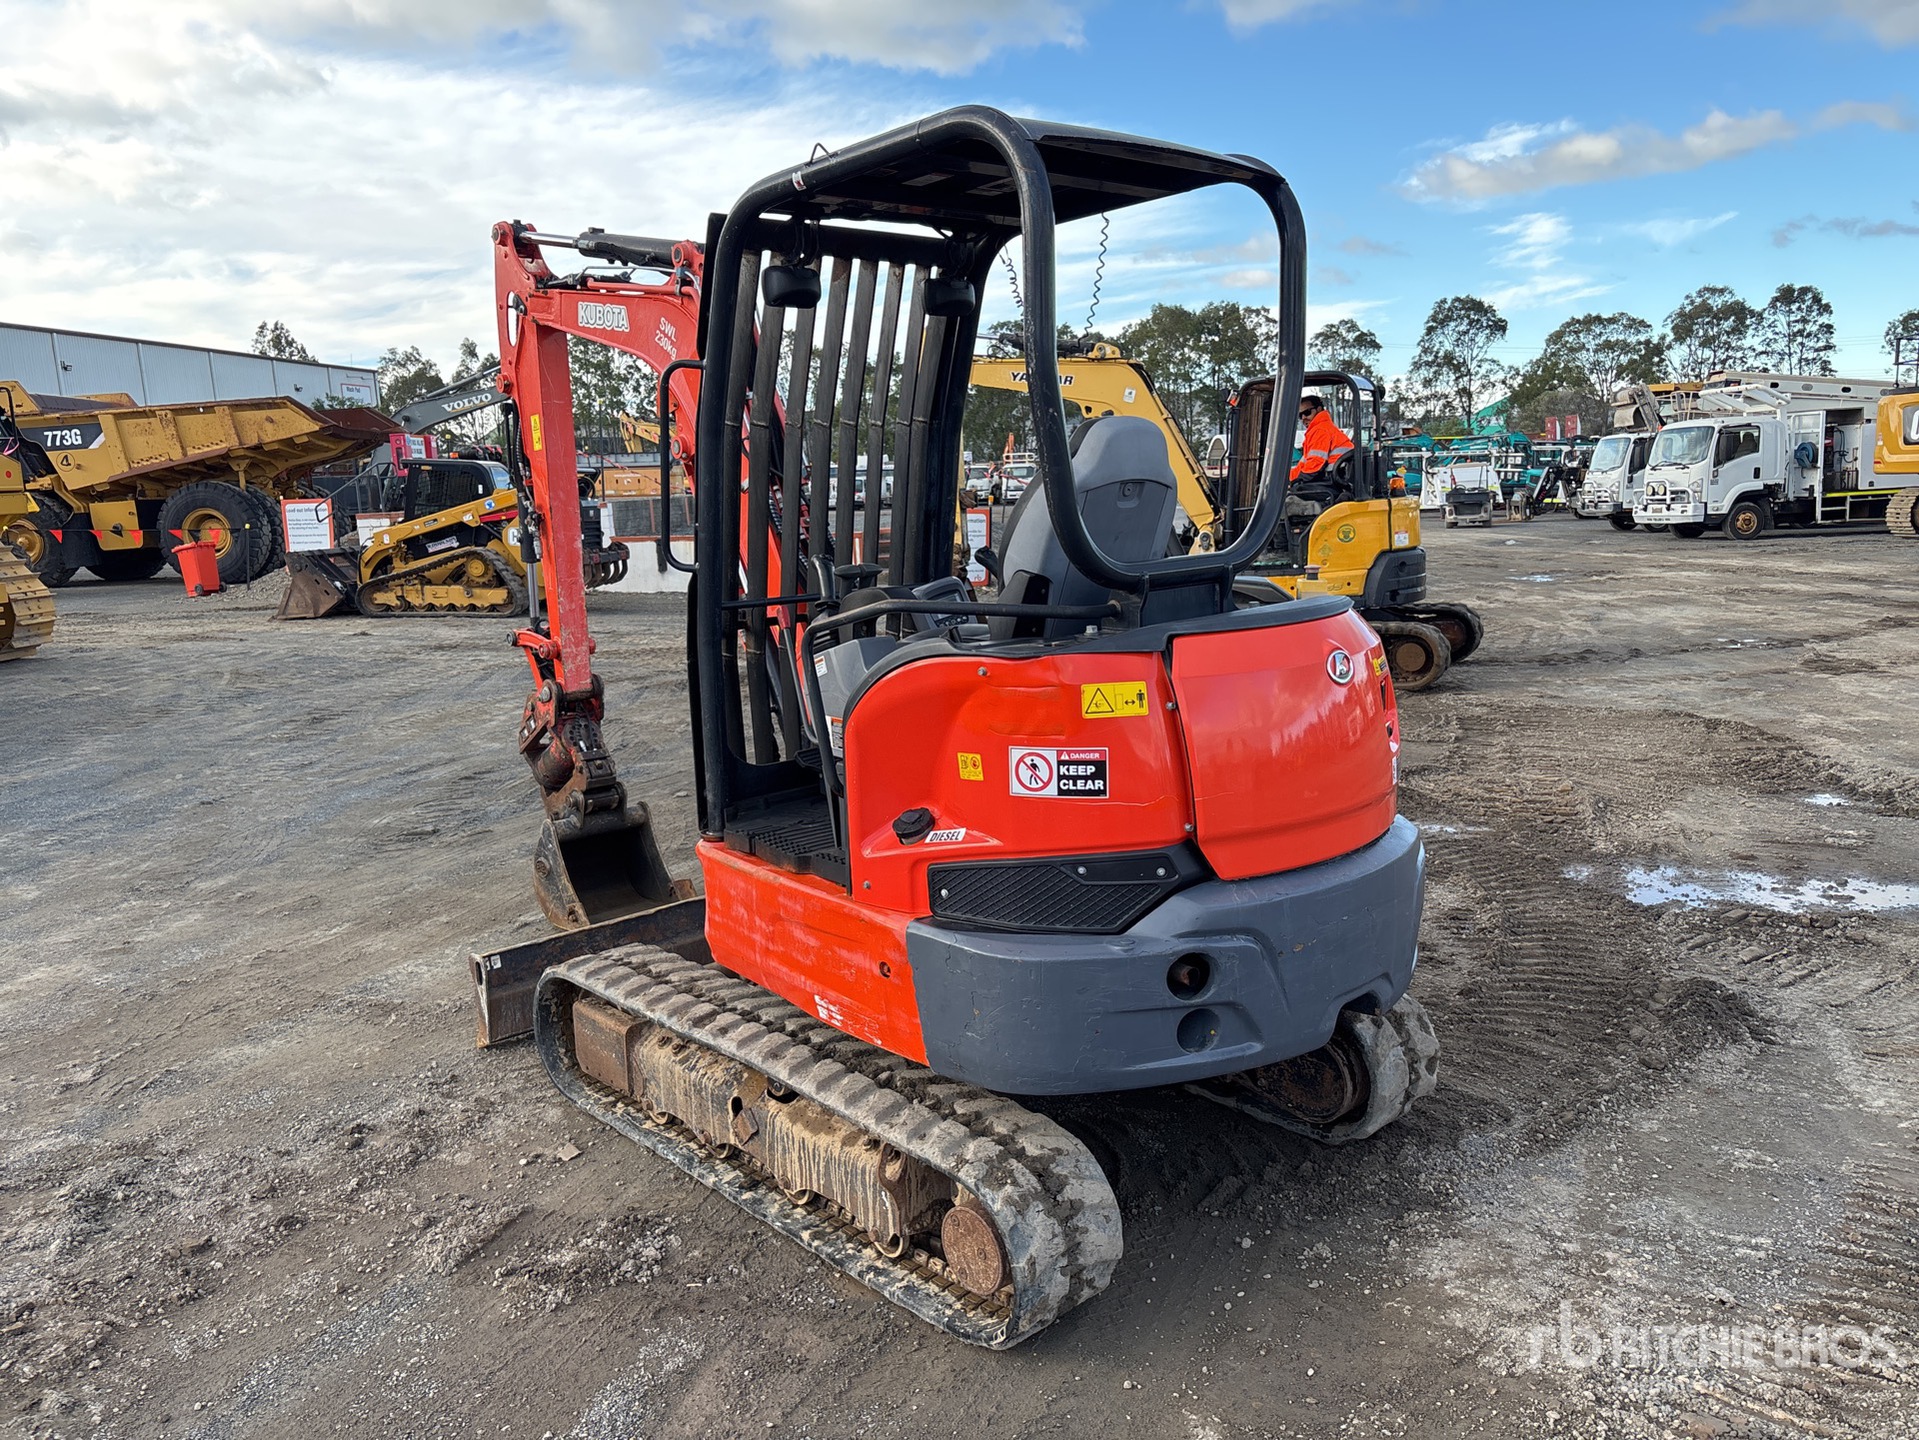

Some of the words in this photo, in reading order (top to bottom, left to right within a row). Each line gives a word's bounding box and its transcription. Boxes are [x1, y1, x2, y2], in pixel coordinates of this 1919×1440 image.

[578, 302, 630, 331] KUBOTA
[660, 317, 676, 341] SWL
[655, 330, 677, 360] 230kg
[441, 393, 492, 411] VOLVO
[43, 428, 83, 447] 773G
[1070, 752, 1100, 760] DANGER
[1060, 765, 1096, 776] KEEP
[1060, 780, 1104, 790] CLEAR
[929, 830, 962, 842] DIESEL
